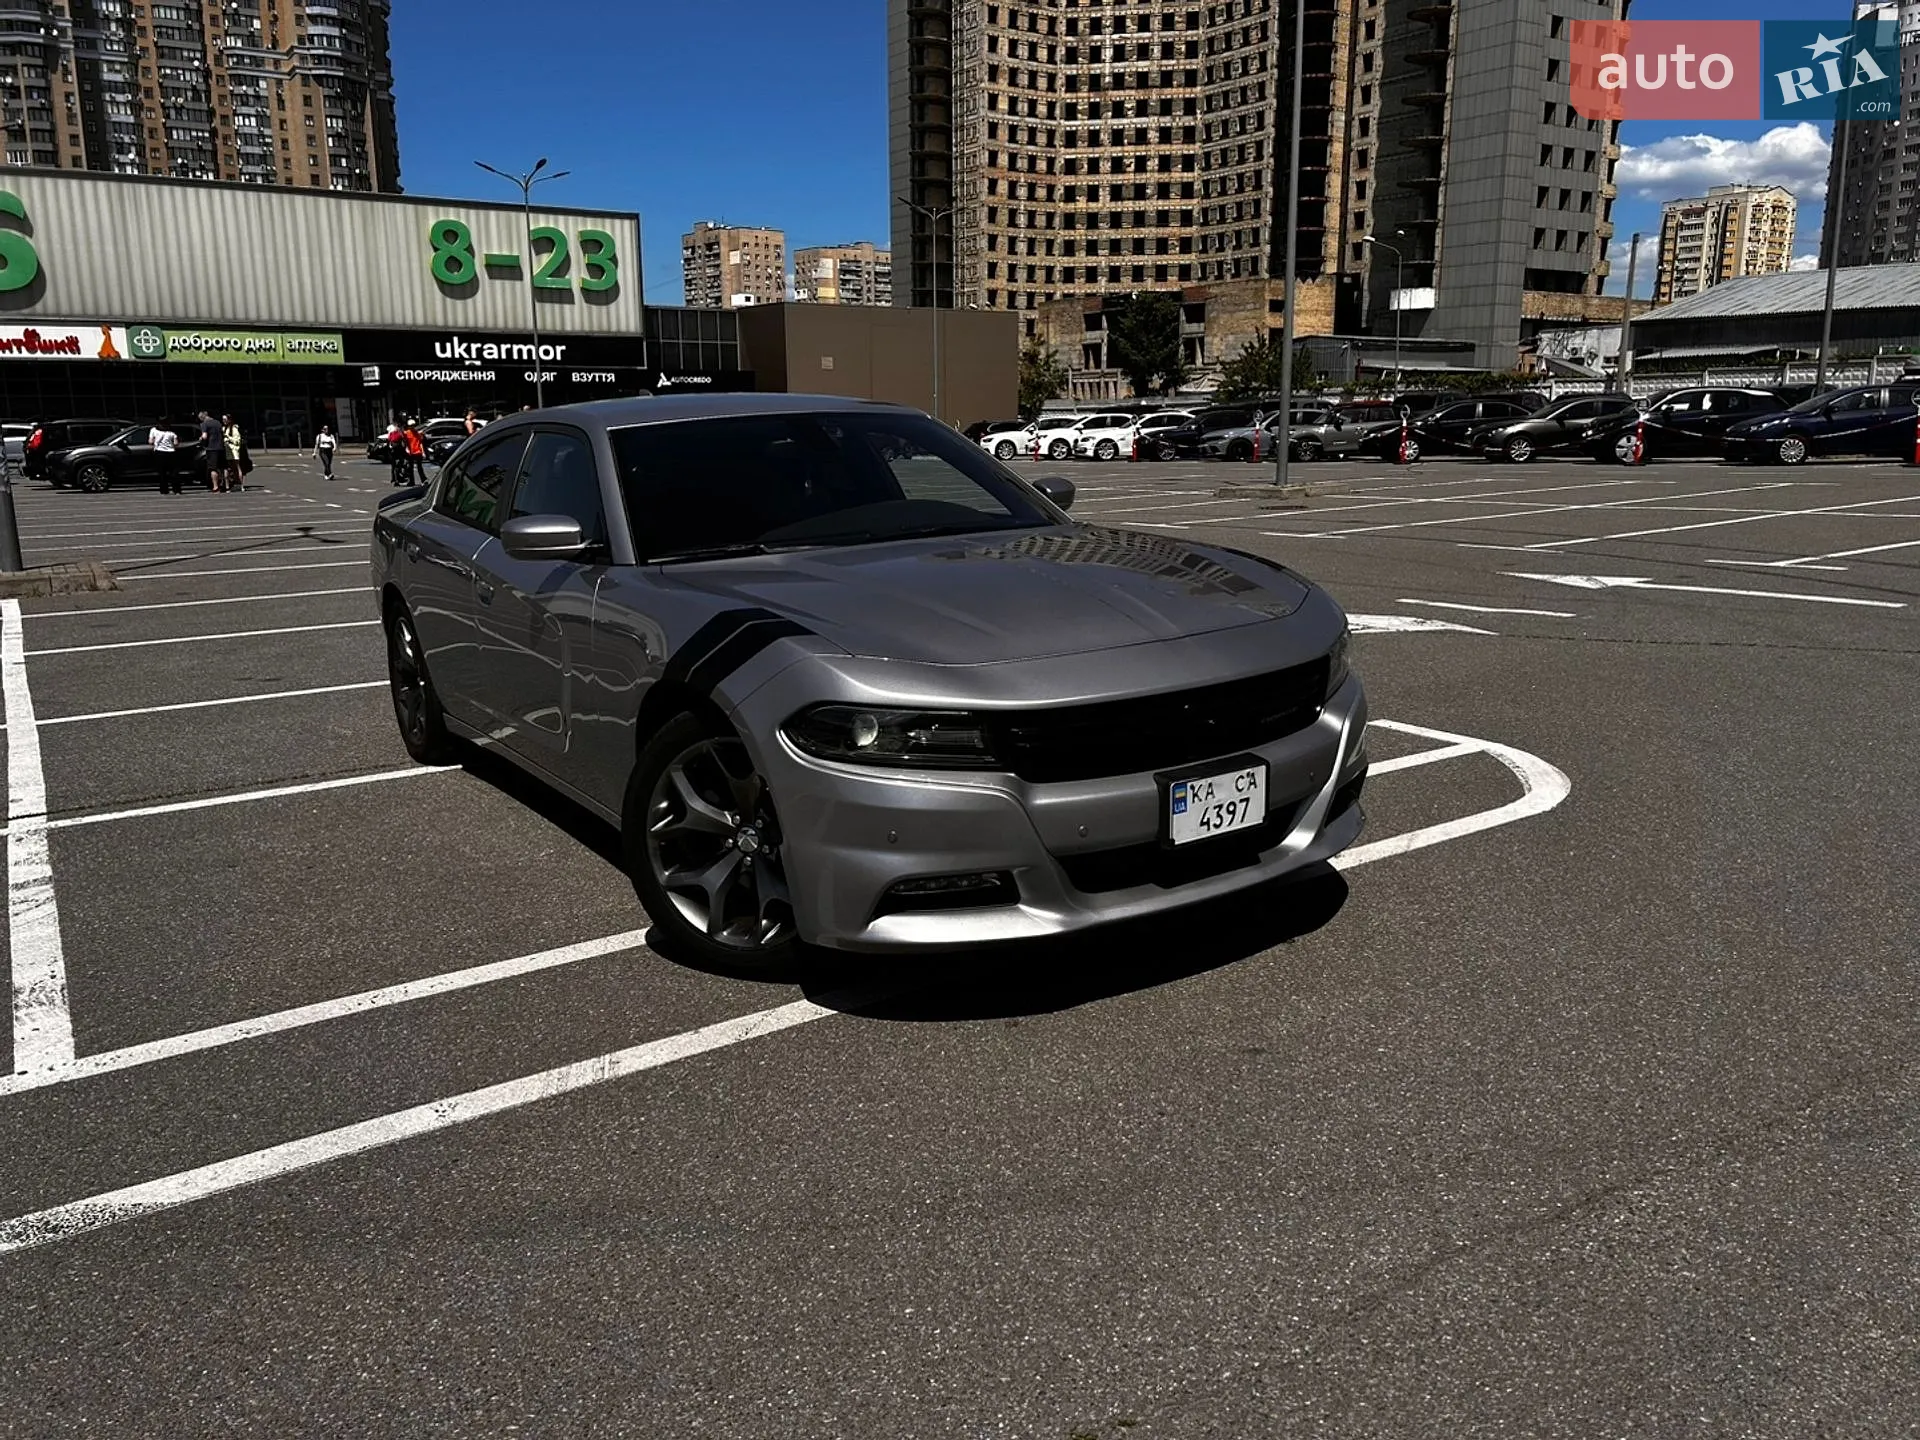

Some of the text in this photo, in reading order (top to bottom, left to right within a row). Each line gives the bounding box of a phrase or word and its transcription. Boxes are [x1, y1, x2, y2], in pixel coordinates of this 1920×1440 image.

[168, 333, 276, 353] доброго дня
[286, 339, 338, 351] аптека
[434, 336, 566, 361] ukrarmor
[395, 369, 616, 383] СПОРЯДЖЕННЯ ОДЯГ ВЗУТТЯ
[670, 376, 712, 384] AUTOCREDO
[1199, 796, 1251, 832] 4397
